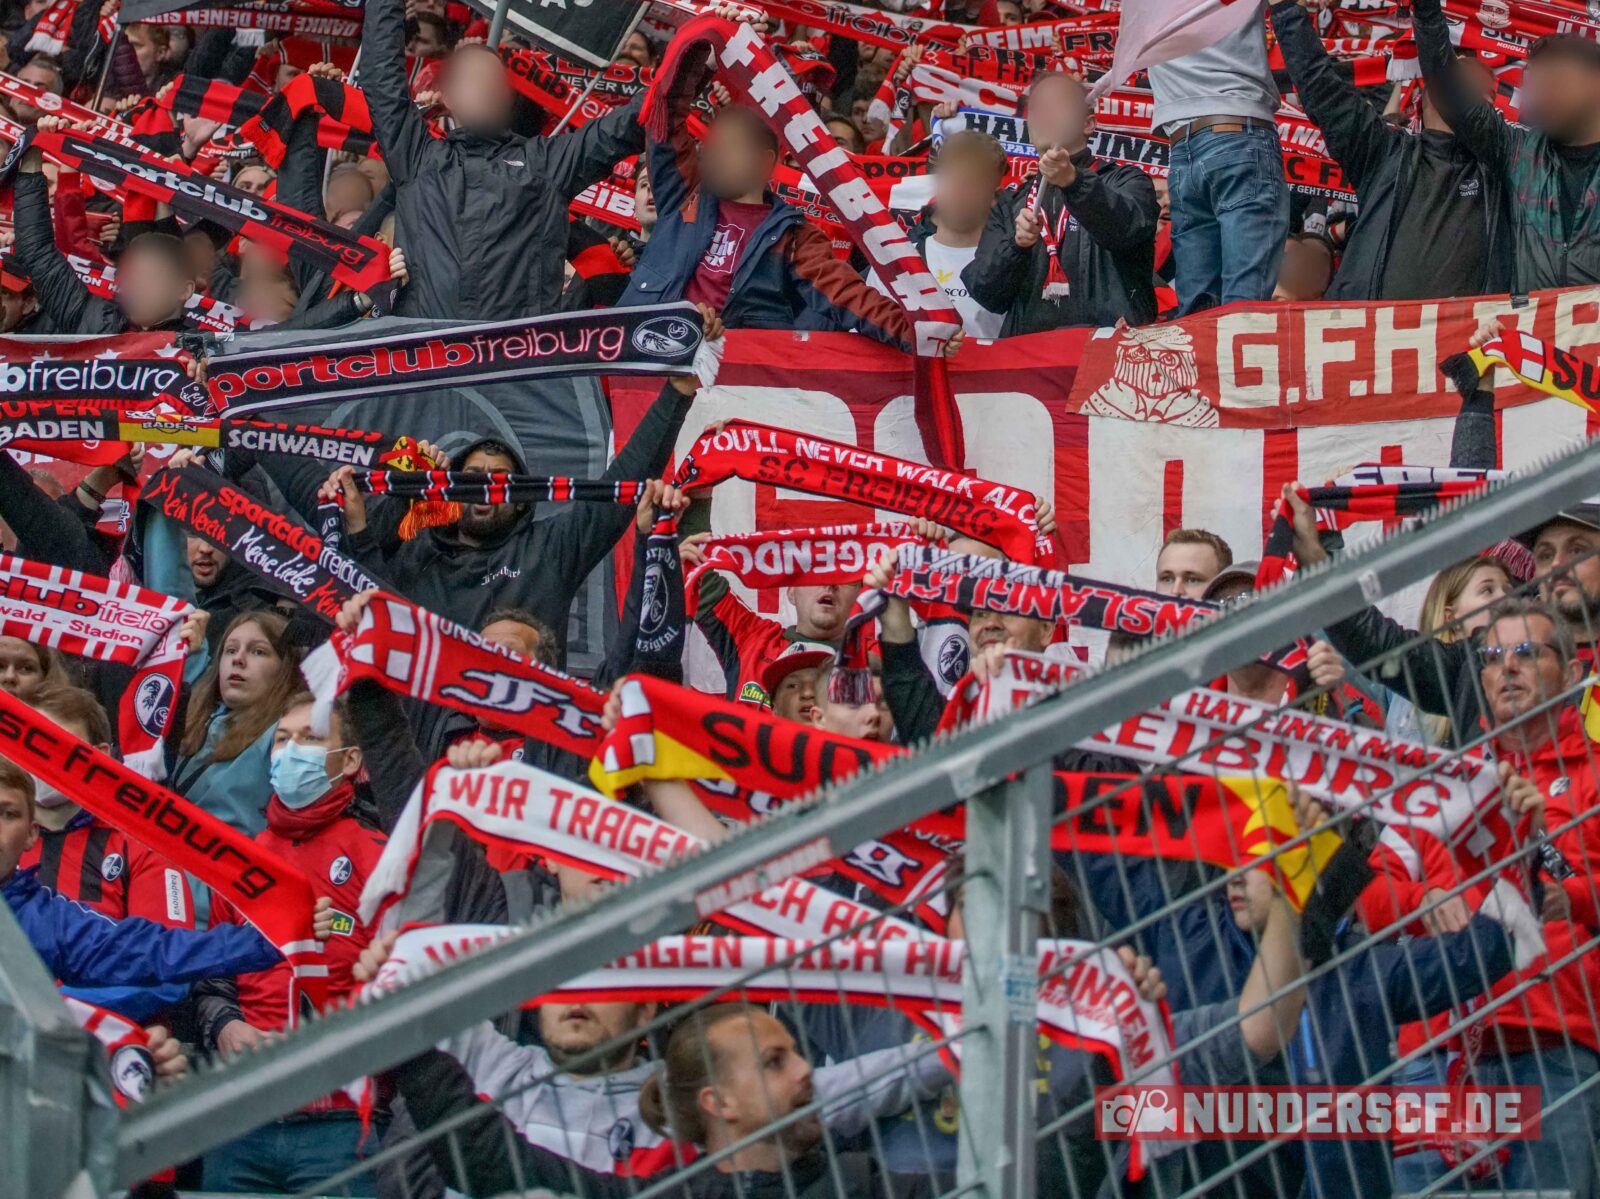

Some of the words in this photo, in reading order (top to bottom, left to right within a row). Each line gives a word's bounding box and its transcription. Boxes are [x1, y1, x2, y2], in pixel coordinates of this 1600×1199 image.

[471, 325, 626, 362] freiburg
[27, 360, 180, 397] freiburg
[228, 428, 375, 466] SCHWABEN
[700, 426, 789, 456] YOU'LL
[795, 437, 885, 472] NEVER
[896, 462, 975, 500] WALK
[758, 455, 810, 485] SC
[821, 465, 998, 538] FREIBURG
[219, 487, 323, 562] sportclub
[69, 619, 144, 646] Stadion
[1185, 693, 1253, 726] HAT
[449, 773, 530, 822] WIR
[63, 749, 276, 899] freiburg
[171, 874, 180, 916] badenova
